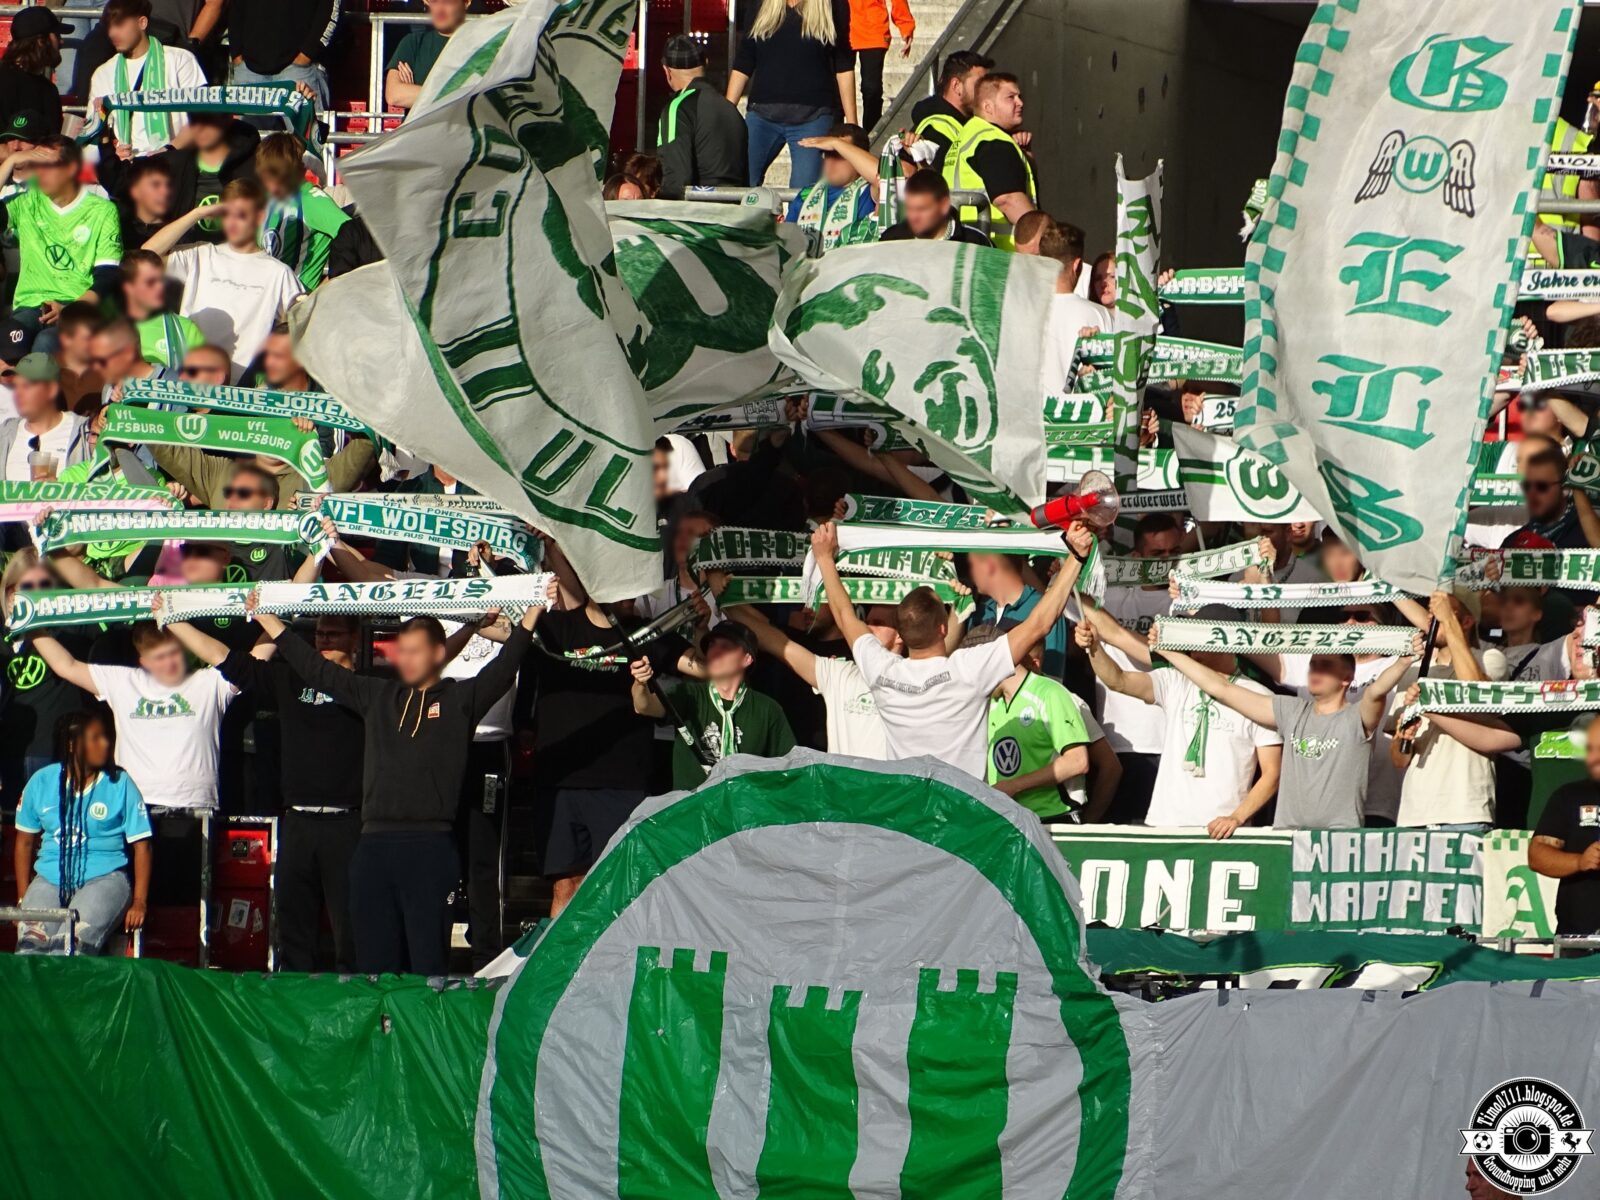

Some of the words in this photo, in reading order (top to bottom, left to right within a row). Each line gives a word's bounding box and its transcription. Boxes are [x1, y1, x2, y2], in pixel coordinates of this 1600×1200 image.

[226, 86, 286, 106] JAHRE
[1527, 271, 1579, 291] Jahre
[115, 409, 137, 420] VfL
[218, 401, 317, 419] Wolfsburger
[247, 421, 269, 433] VfL
[218, 430, 292, 450] WOLFSBURG
[71, 512, 298, 533] ARBEITERVEREIN
[328, 500, 372, 525] VFL
[382, 510, 527, 552] WOLFSBURG
[348, 523, 363, 532] DIE
[404, 532, 424, 540] AUS
[302, 578, 493, 603] ANGELS
[1206, 627, 1364, 647] ANGELS
[1291, 880, 1482, 924] WAPPEN
